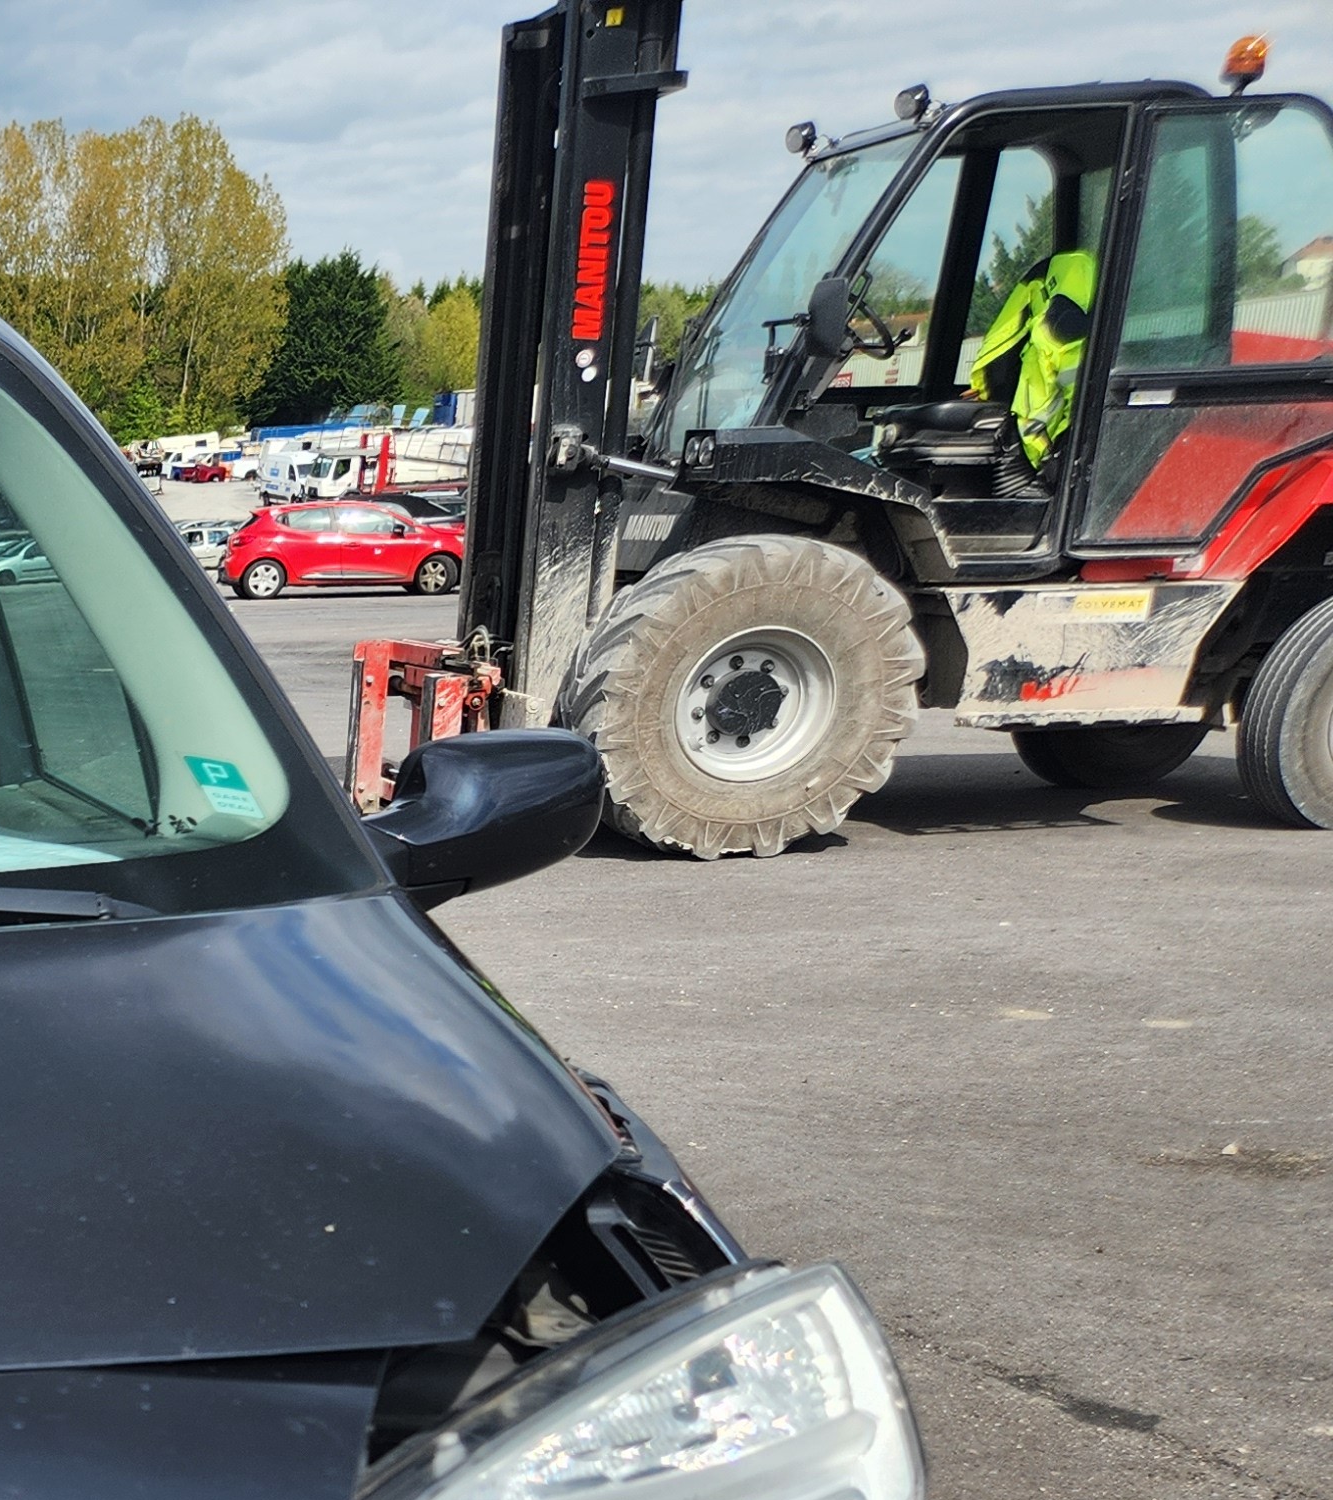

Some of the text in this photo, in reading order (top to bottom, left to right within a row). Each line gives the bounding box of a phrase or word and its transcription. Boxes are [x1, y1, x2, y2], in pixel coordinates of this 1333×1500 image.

[572, 181, 614, 341] MANITOU
[622, 514, 677, 541] MANITOU
[201, 762, 229, 784] P
